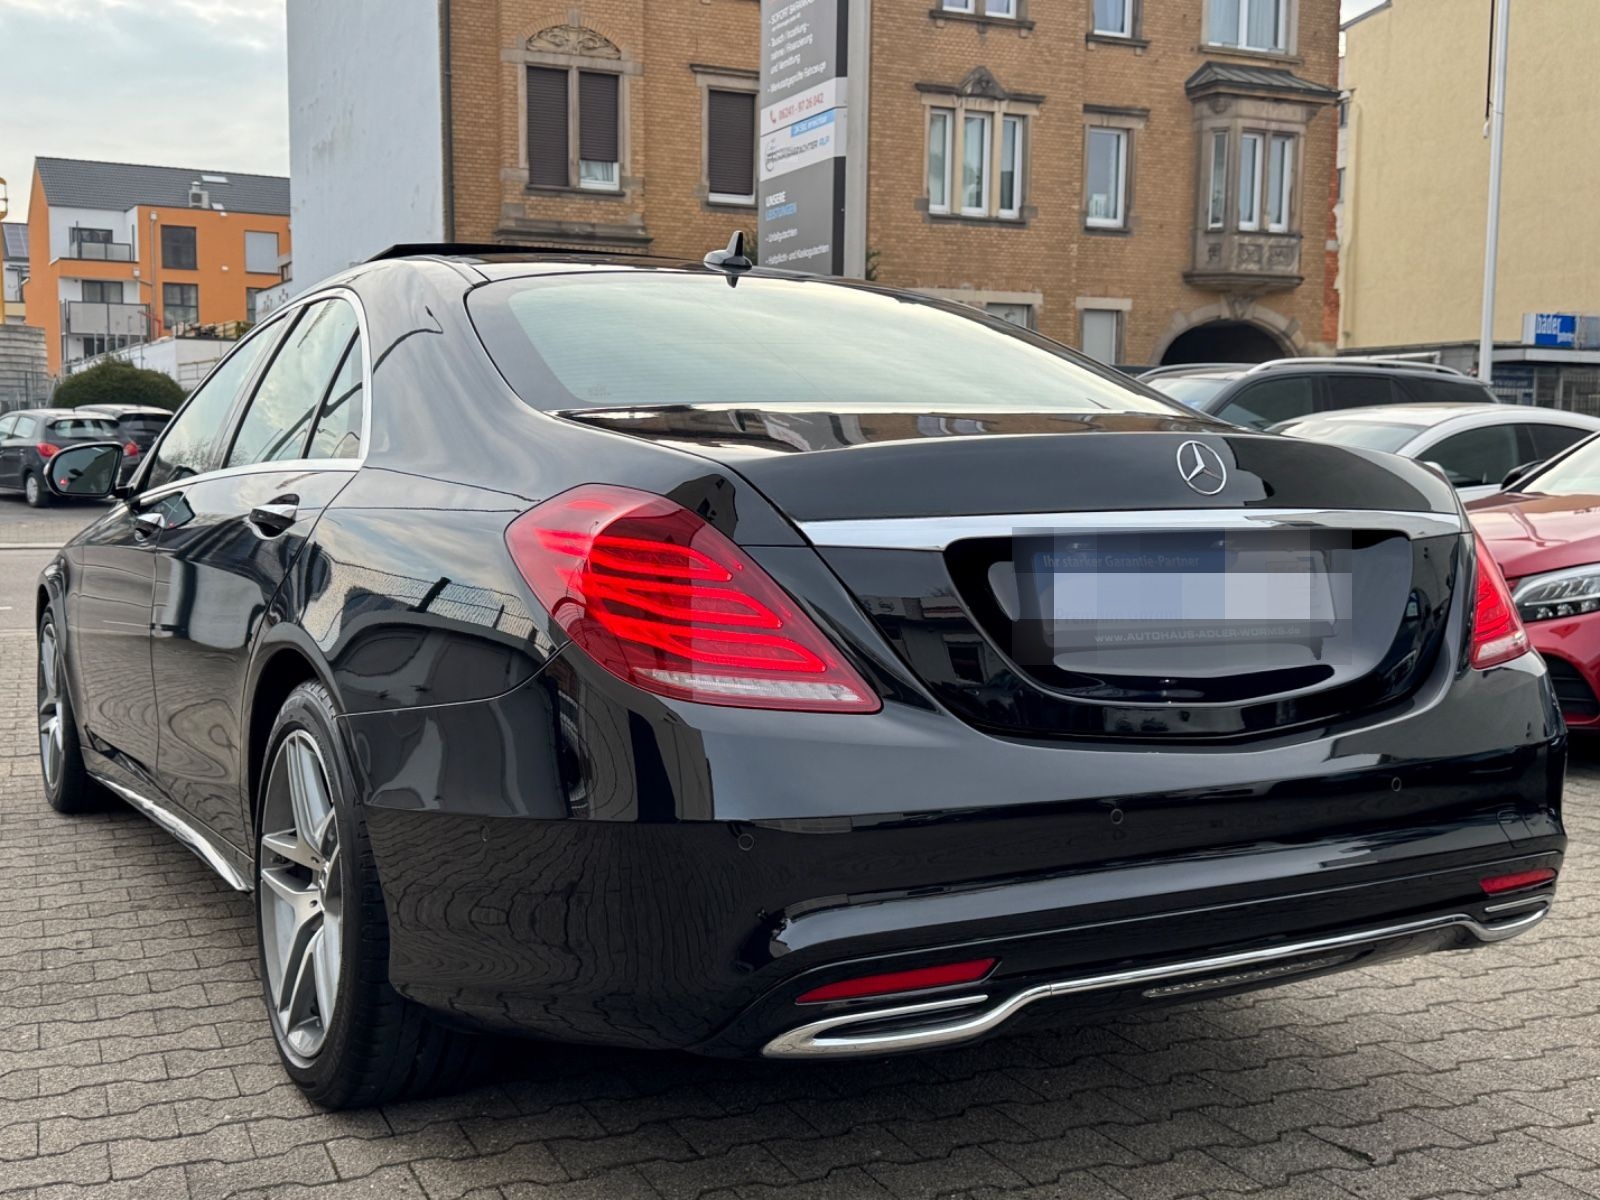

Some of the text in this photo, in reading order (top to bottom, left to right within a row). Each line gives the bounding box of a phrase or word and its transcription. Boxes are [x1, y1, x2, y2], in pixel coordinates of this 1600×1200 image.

[1043, 553, 1200, 568] Ihr starker Garantie-Partner
